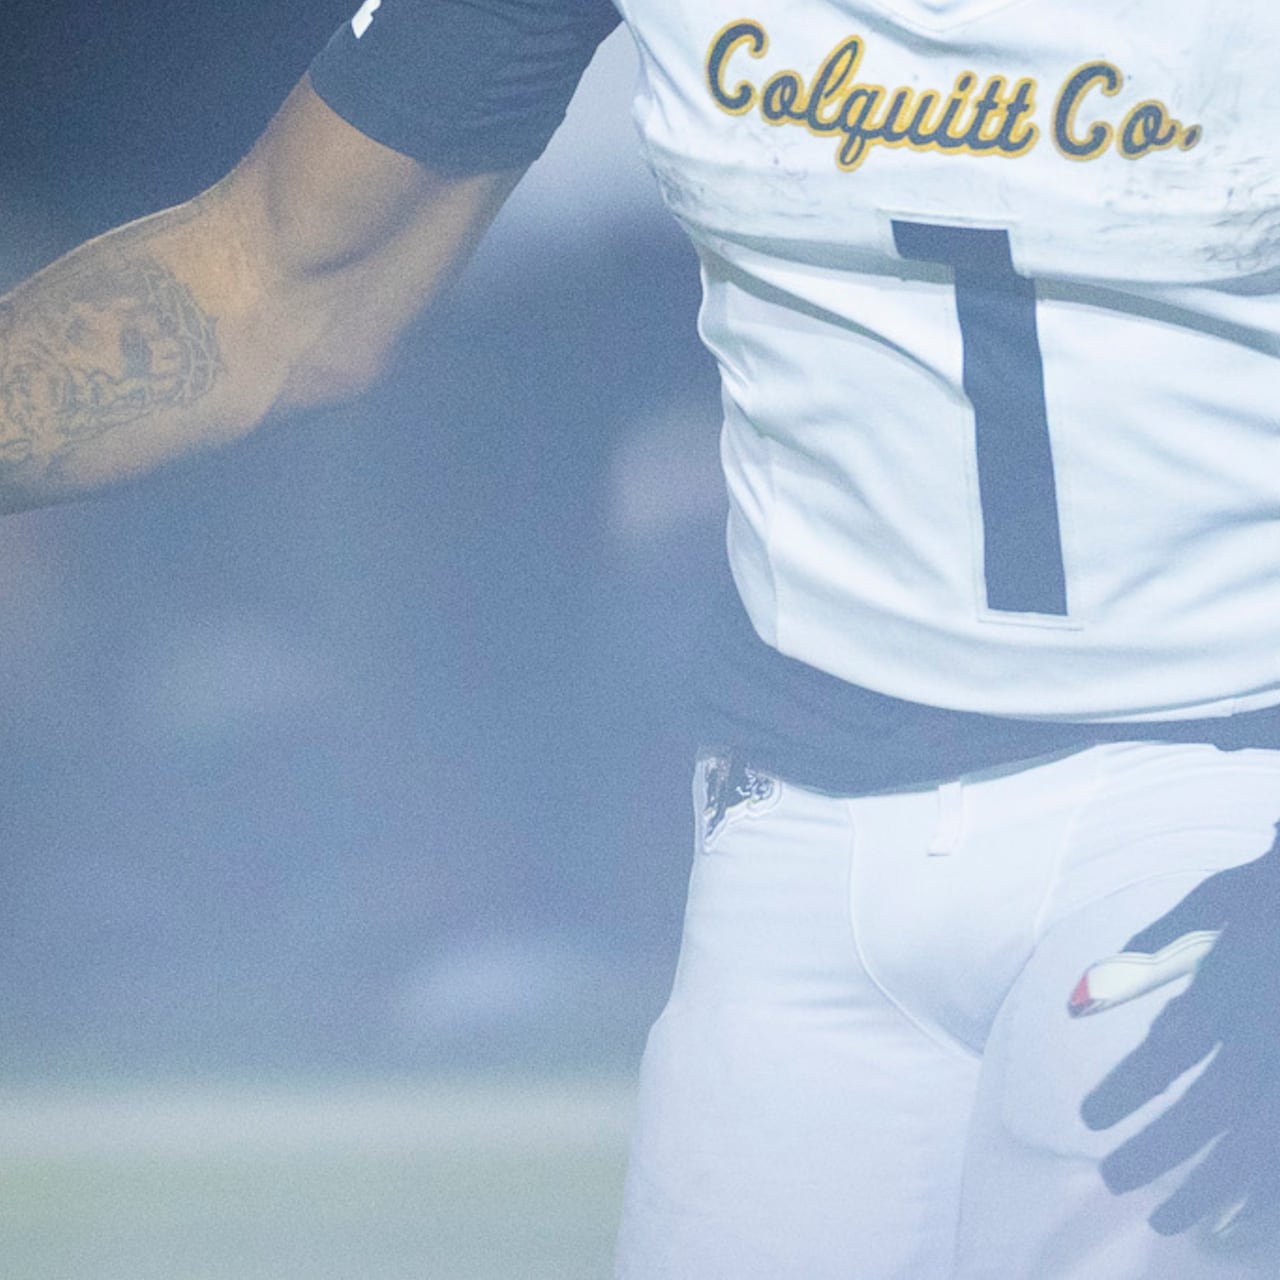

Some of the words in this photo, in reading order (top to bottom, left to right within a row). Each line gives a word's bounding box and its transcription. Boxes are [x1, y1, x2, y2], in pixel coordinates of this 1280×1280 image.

[706, 18, 1038, 172] Colquitt
[1053, 62, 1201, 161] Co.
[890, 219, 1068, 616] 1
